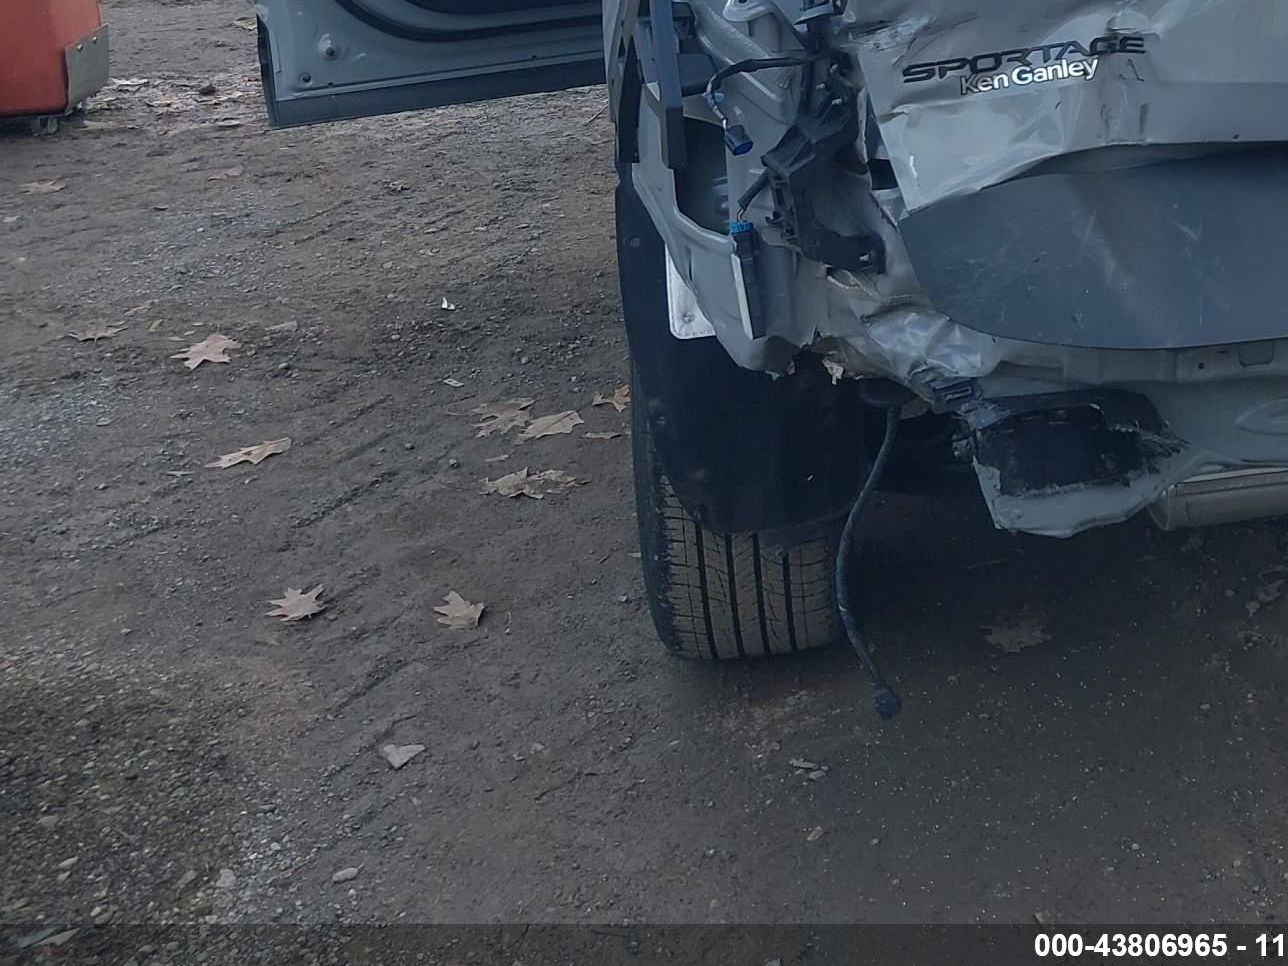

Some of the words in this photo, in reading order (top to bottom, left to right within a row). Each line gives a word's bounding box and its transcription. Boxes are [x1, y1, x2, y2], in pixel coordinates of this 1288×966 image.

[902, 36, 1146, 83] SPORTAGE
[960, 70, 1009, 96] Ken
[1012, 57, 1099, 85] Ganley
